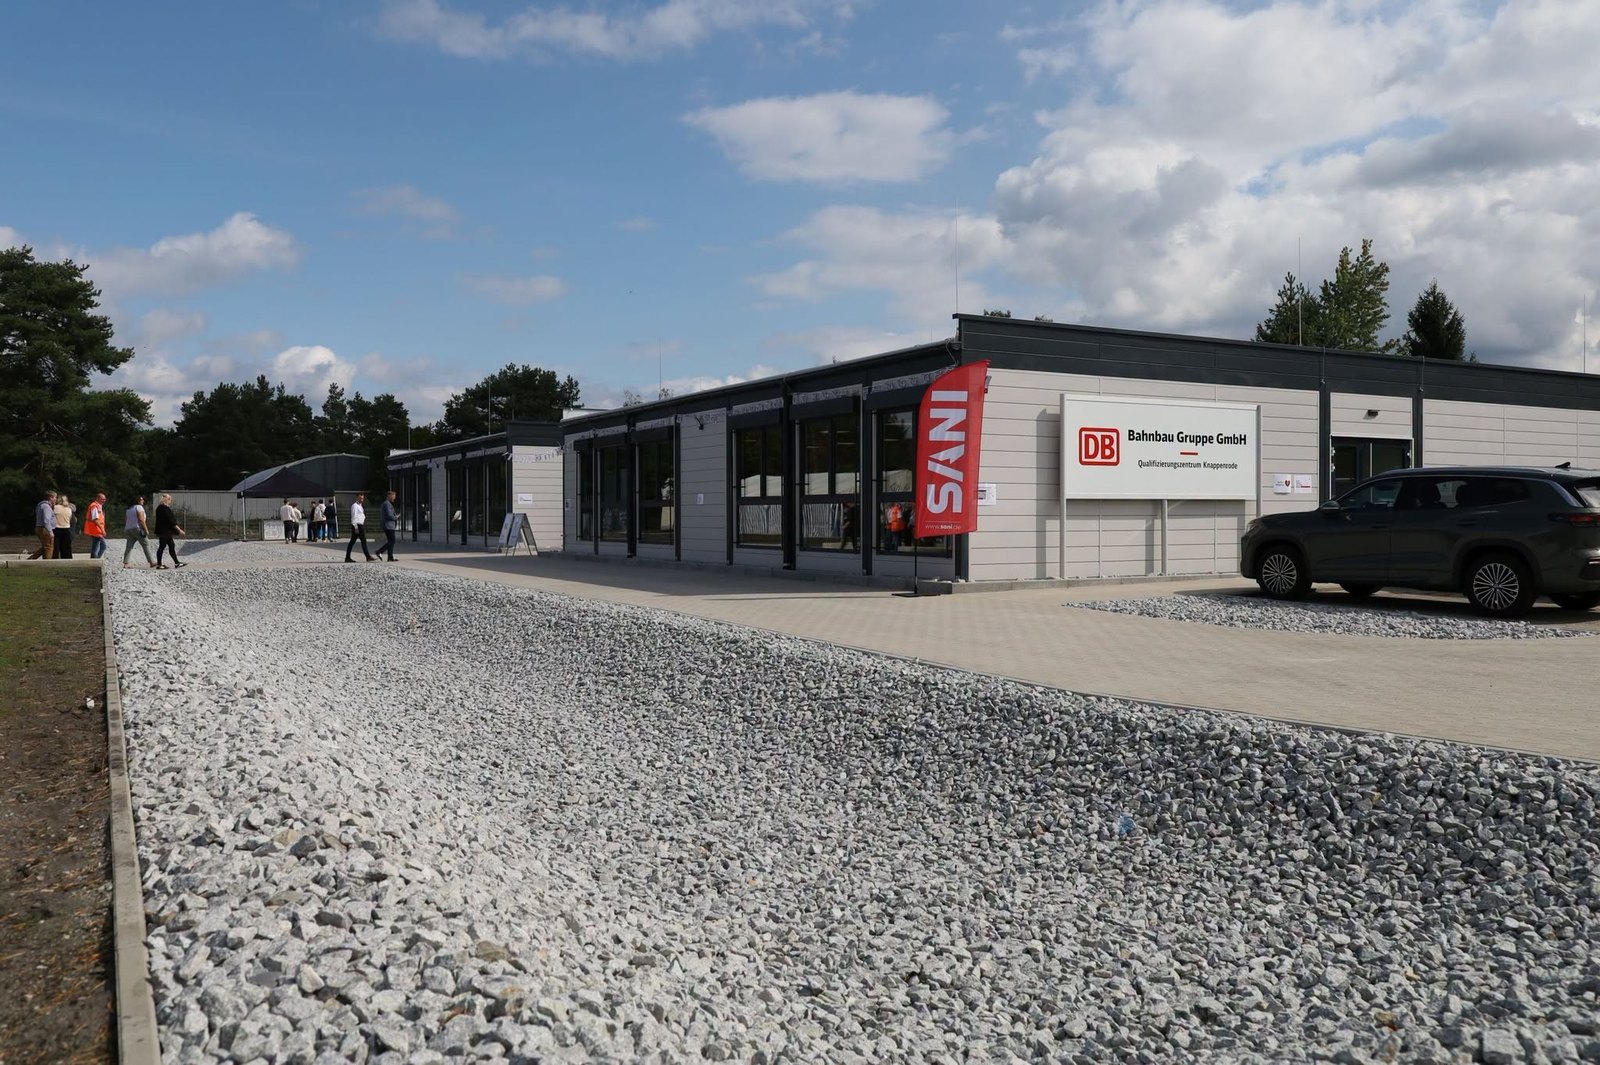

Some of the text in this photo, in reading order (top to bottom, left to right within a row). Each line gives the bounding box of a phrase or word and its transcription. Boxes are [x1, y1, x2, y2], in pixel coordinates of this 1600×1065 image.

[1083, 433, 1115, 460] DB
[1128, 430, 1247, 446] Bahnbau Gruppe GmbH
[927, 391, 968, 513] SANI
[1138, 459, 1238, 470] Qualifizierungszentrum Knappenrode
